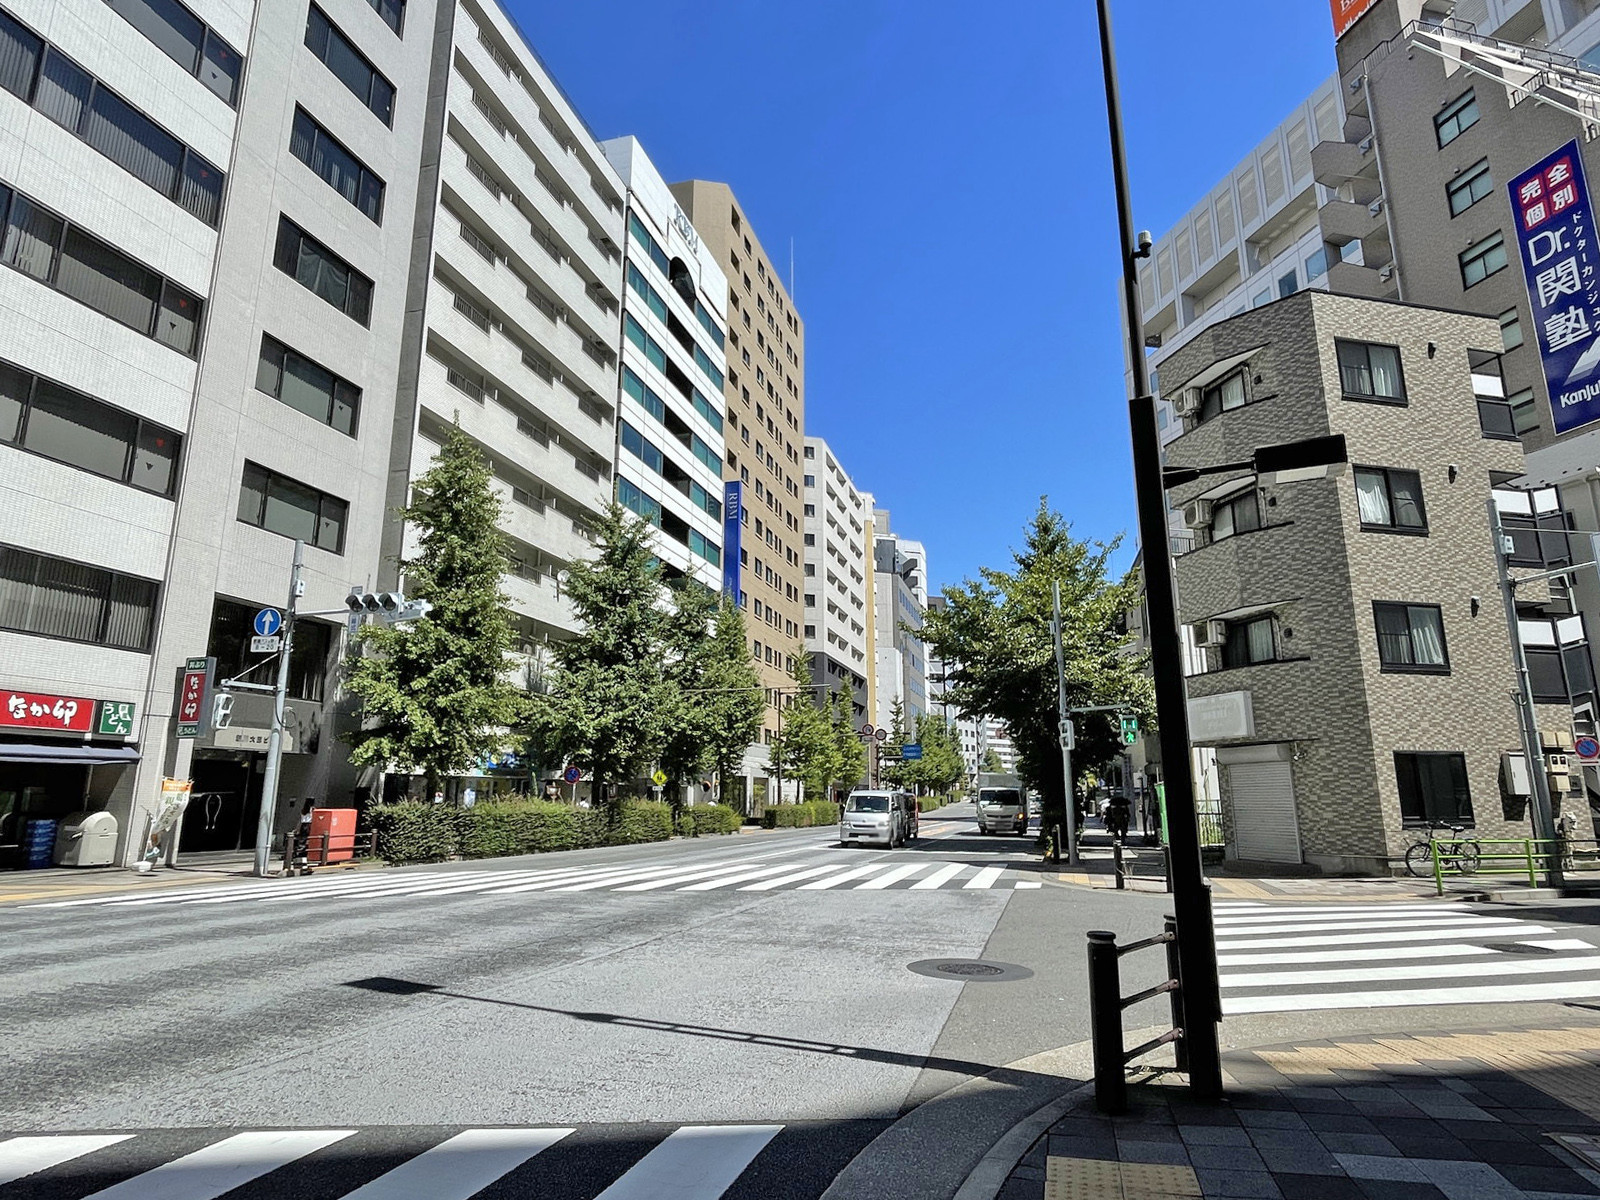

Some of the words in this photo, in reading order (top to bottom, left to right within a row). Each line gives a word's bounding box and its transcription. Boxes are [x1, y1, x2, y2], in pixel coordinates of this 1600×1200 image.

[1521, 163, 1570, 204] 完全
[1525, 184, 1574, 227] 個別
[1528, 226, 1571, 267] Dr.
[1536, 256, 1592, 353] 関塾
[729, 492, 738, 519] RBM
[8, 694, 78, 728] なか卯
[184, 676, 199, 718] なか卯
